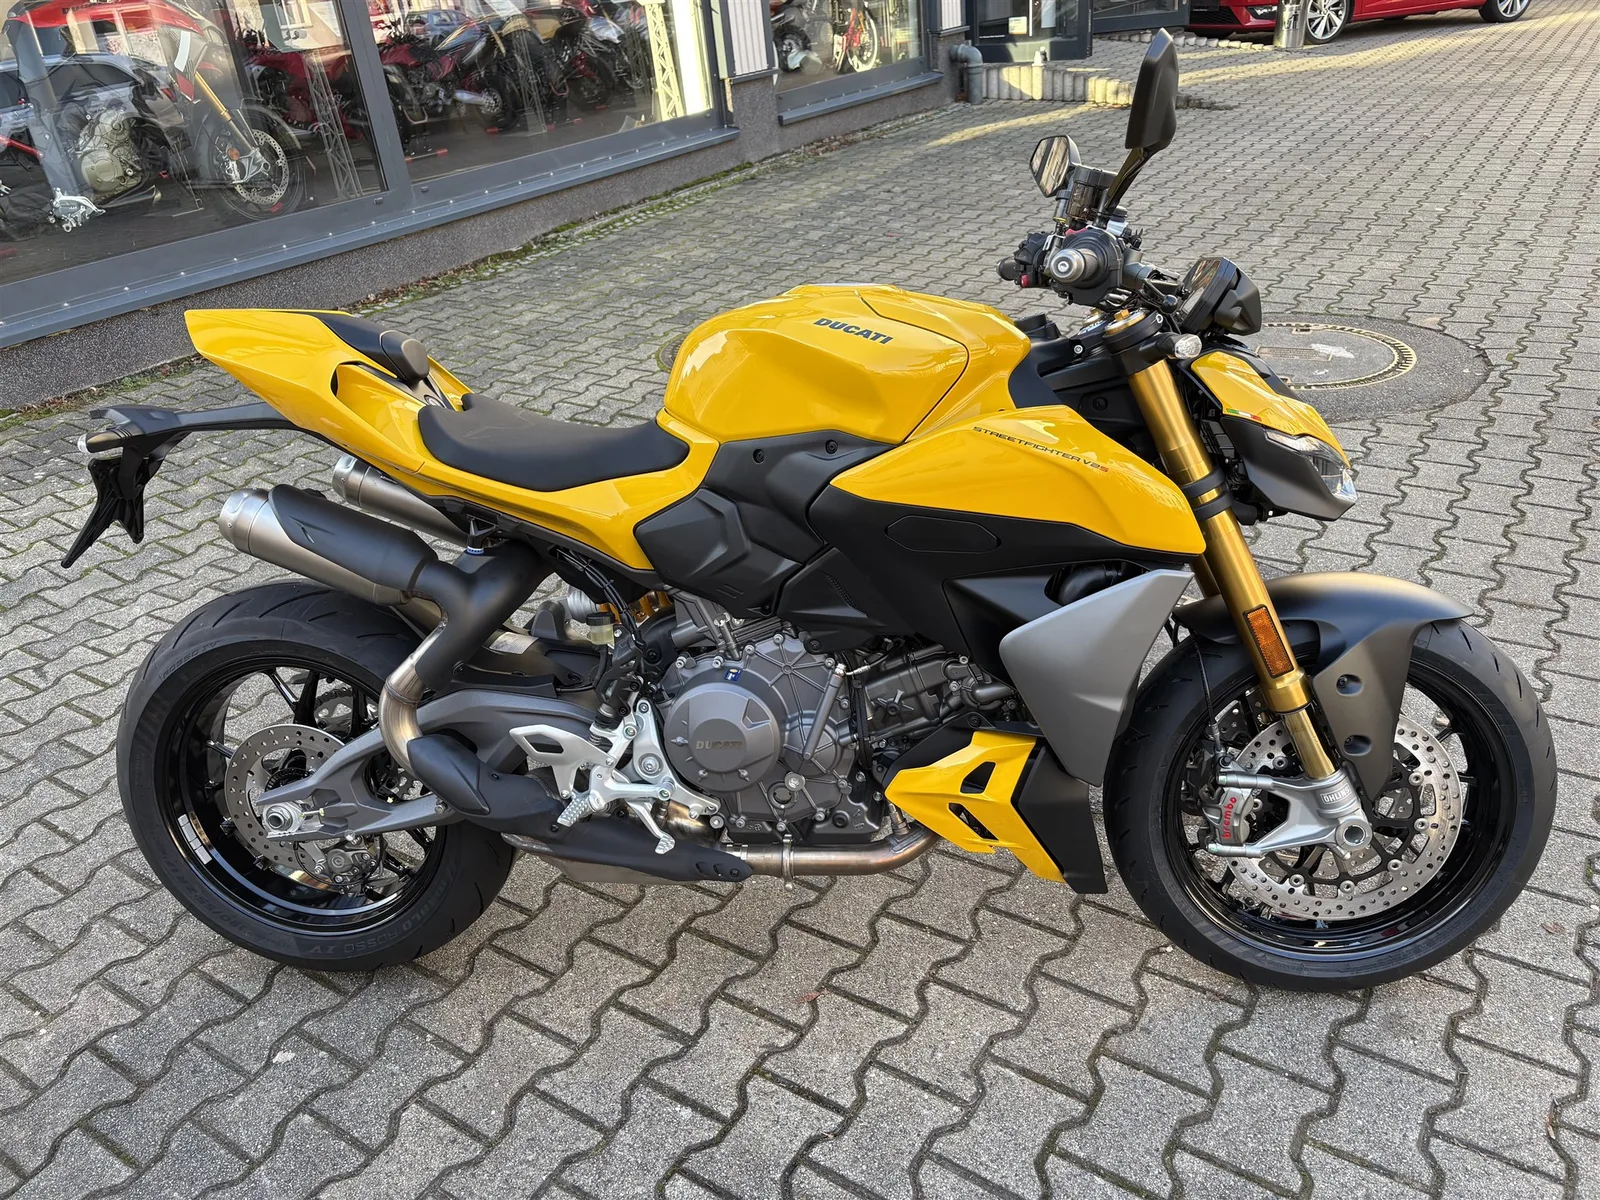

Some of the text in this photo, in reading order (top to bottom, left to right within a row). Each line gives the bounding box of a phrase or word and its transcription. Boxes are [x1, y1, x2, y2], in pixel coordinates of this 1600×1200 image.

[813, 318, 894, 345] DUCATI
[973, 426, 1081, 462] STREETFIGHTER
[1222, 797, 1237, 839] brembo
